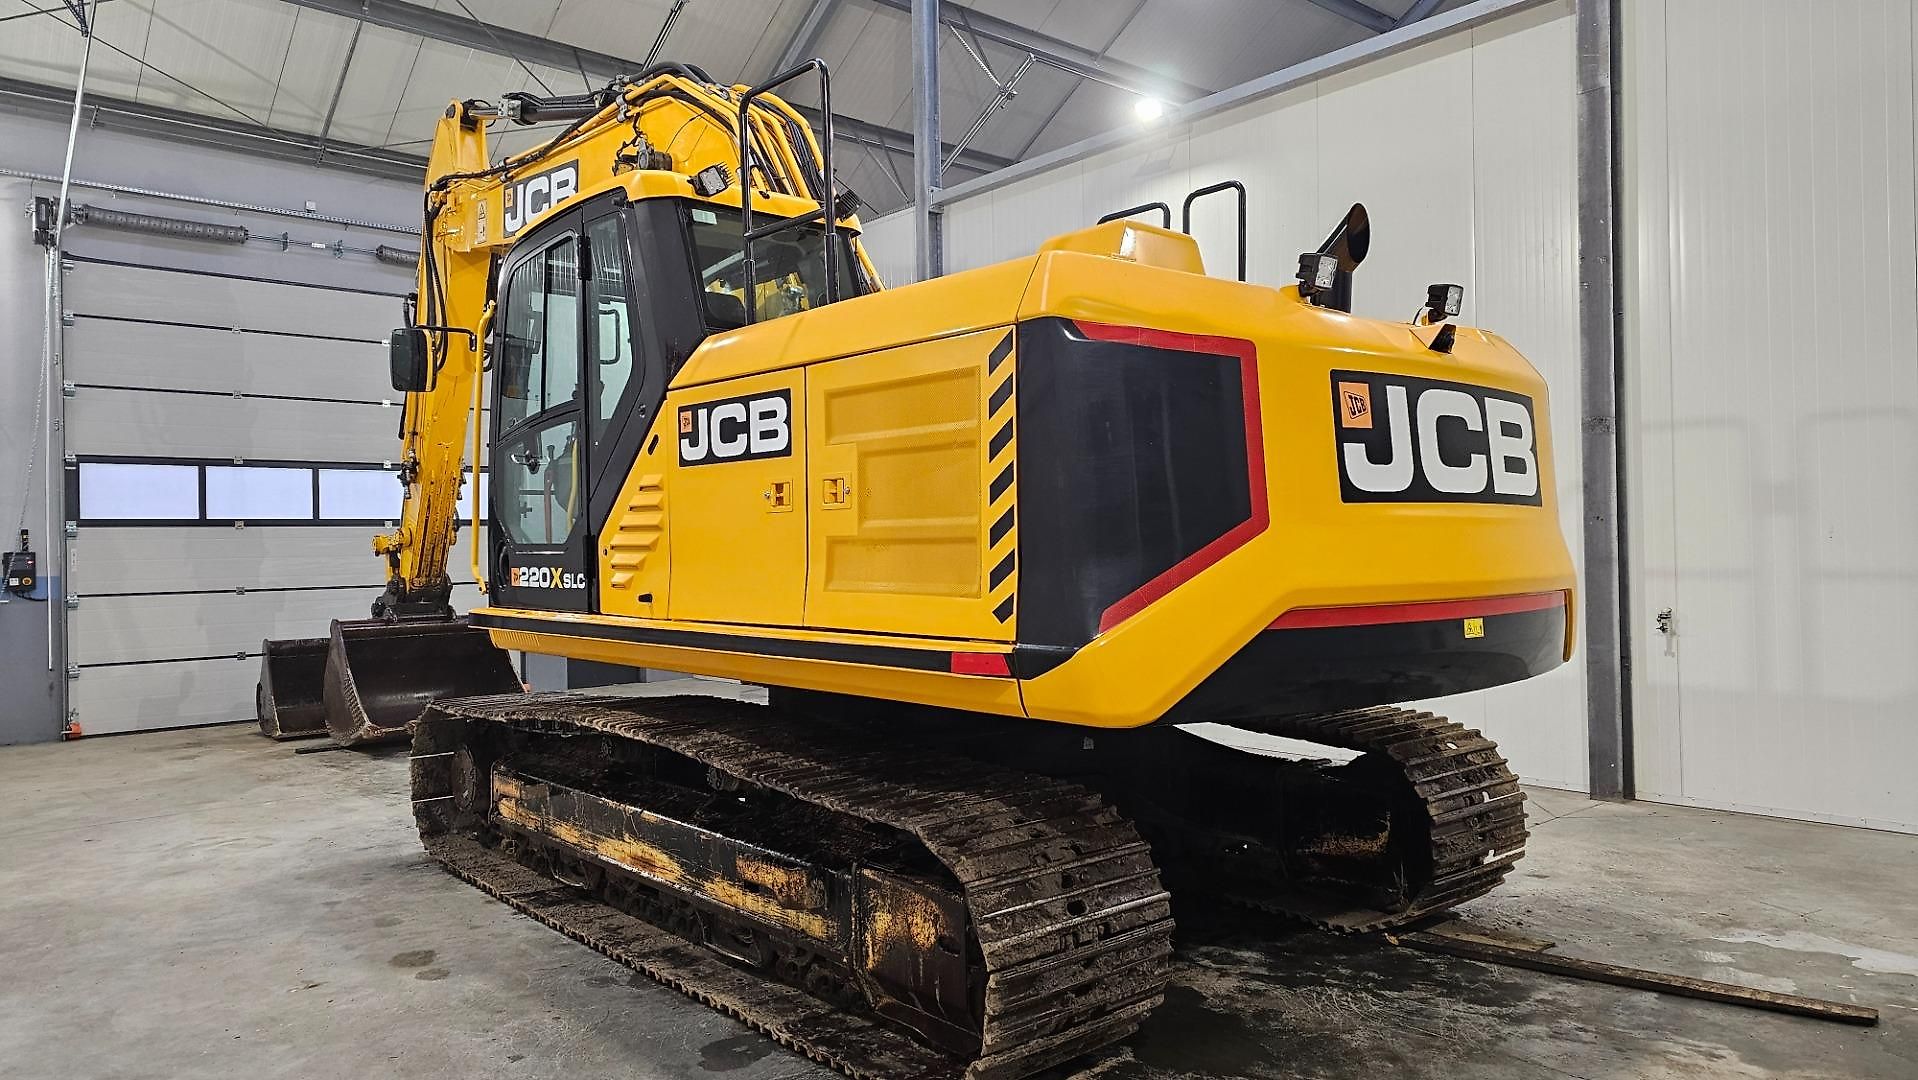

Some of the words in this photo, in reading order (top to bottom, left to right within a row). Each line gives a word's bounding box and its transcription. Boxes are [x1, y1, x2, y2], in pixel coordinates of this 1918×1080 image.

[505, 167, 576, 232] JCB
[680, 397, 789, 461] JCB
[1347, 394, 1367, 416] JCB
[1343, 385, 1538, 497] JCB
